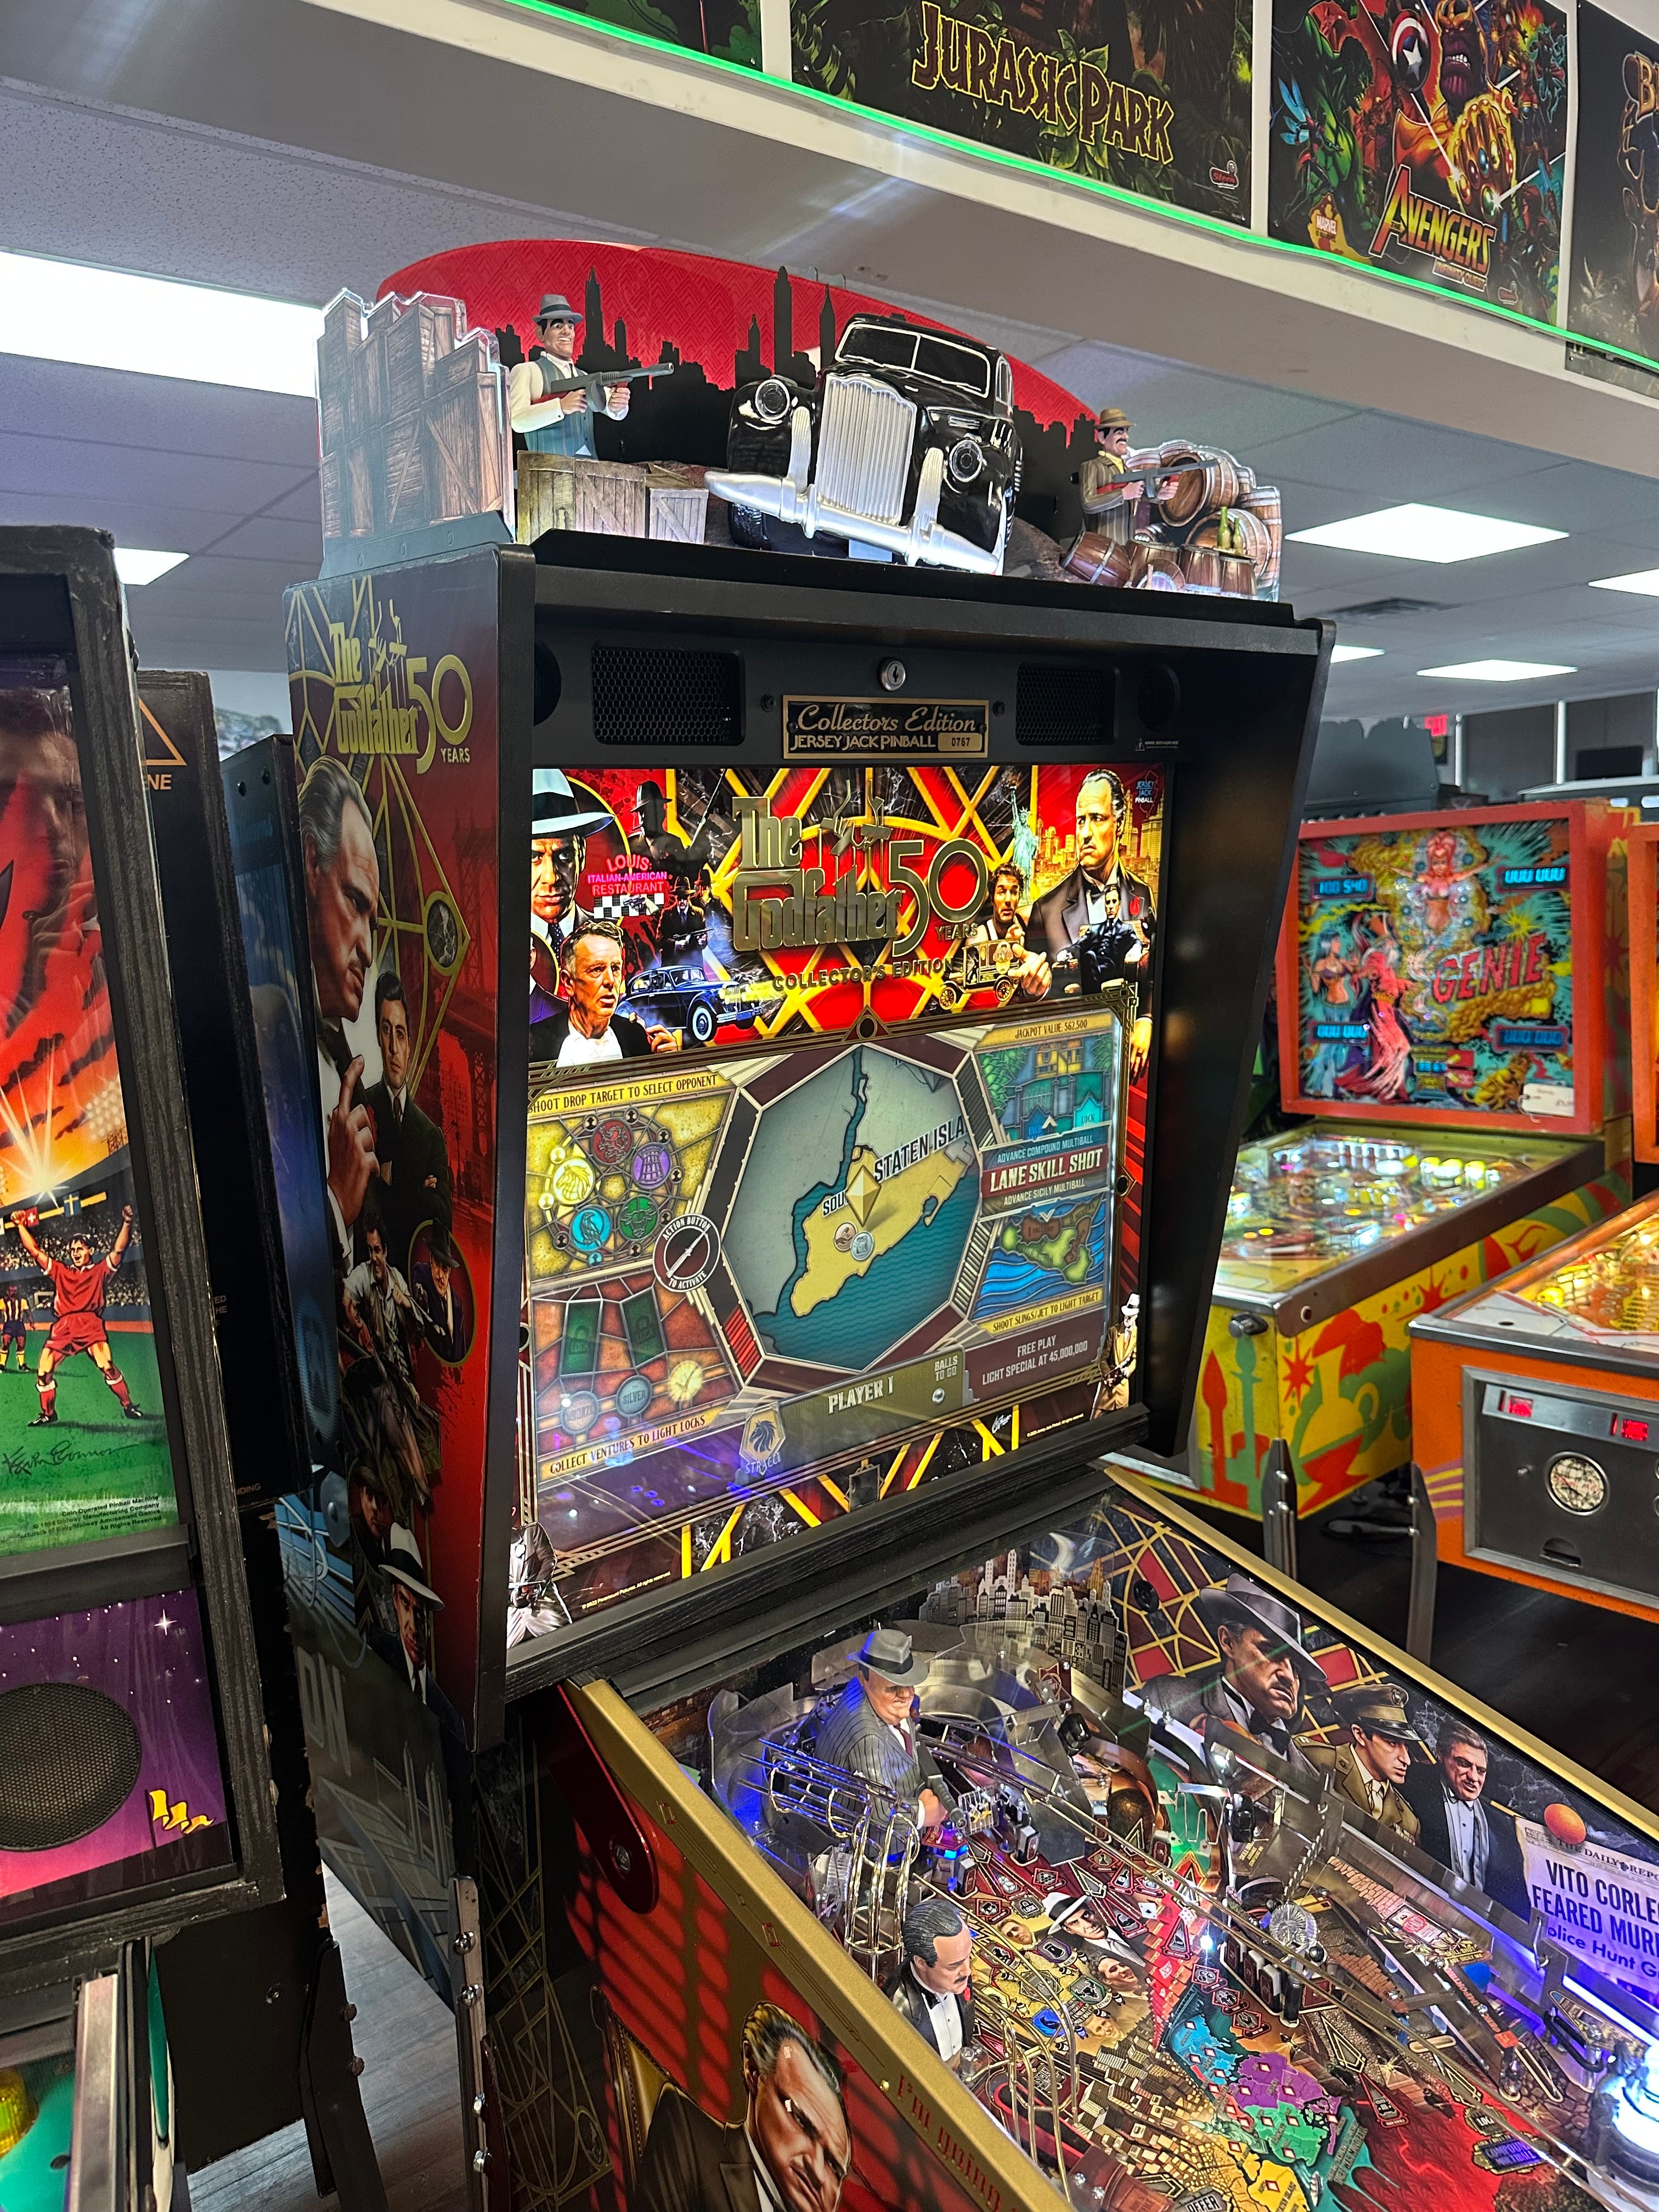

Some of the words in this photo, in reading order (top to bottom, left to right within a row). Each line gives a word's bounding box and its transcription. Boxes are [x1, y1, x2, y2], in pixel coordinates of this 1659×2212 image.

[911, 1, 1076, 135] JURASSIC
[1079, 61, 1175, 166] PARK
[1372, 166, 1496, 273] AVENGERS
[330, 622, 363, 684] The
[334, 681, 420, 754] Godfather
[406, 654, 473, 775] 50
[798, 703, 899, 732] Collectors
[905, 706, 976, 732] Edition
[440, 747, 471, 764] YEARS
[790, 735, 843, 751] JERSEY
[842, 735, 879, 751] JACK
[881, 735, 936, 751] PINBALL
[951, 737, 971, 747] 0767
[1138, 789, 1153, 798] JACK
[732, 796, 803, 869] The
[588, 871, 667, 884] ITALIAN-AMERICAN
[592, 881, 664, 896] RESTAURANT
[733, 868, 902, 952] Godfather
[888, 838, 989, 958] 50
[935, 923, 979, 941] YEARS
[772, 962, 885, 992] COLLECTOR'S
[891, 957, 955, 978] EDITION
[1432, 934, 1546, 1004] GENIE
[1015, 1026, 1042, 1039] JACKPOT
[563, 1094, 587, 1109] DROP
[590, 1088, 625, 1104] TARGET
[628, 1086, 640, 1098] TO
[643, 1081, 674, 1096] SELECT
[676, 1074, 718, 1091] OPPONENT
[873, 1132, 929, 1182] STATEN
[997, 1149, 1026, 1165] ADVANCE
[1027, 1142, 1061, 1158] COMPOUND
[1062, 1134, 1093, 1151] MULTIBALL
[989, 1166, 1028, 1193] LANE
[1029, 1158, 1065, 1182] SKILL
[1068, 1148, 1103, 1172] SHOT
[1003, 1191, 1032, 1206] ADVANCE
[1032, 1187, 1053, 1201] SICILY
[1053, 1178, 1086, 1194] MULTIBALL
[662, 1218, 685, 1240] ACTION
[686, 1216, 712, 1230] BUTTON
[668, 1278, 678, 1288] TO
[678, 1270, 707, 1289] ACTIVATE
[992, 1318, 1013, 1332] SHOOT
[1014, 1307, 1048, 1325] SLINGS/JET
[1050, 1305, 1058, 1313] TO
[1059, 1298, 1077, 1312] LIGHT
[1079, 1291, 1099, 1305] TARGET
[1017, 1341, 1036, 1358] FREE
[1037, 1334, 1057, 1351] PLAY
[934, 1355, 958, 1371] BALLS
[935, 1369, 945, 1381] TO
[946, 1365, 957, 1379] GO
[982, 1368, 1005, 1386] LIGHT
[1006, 1358, 1037, 1378] SPECIAL
[1038, 1353, 1048, 1367] AT
[1048, 1340, 1088, 1362] 45,000,000
[622, 1390, 646, 1405] SILVER
[827, 1379, 884, 1414] PLAYER
[550, 1453, 588, 1474] COLLECT
[590, 1438, 635, 1461] VENTURES
[637, 1434, 650, 1446] TO
[652, 1424, 678, 1442] LIGHT
[680, 1415, 706, 1432] LOCKS
[78, 1504, 108, 1515] Operated
[109, 1500, 131, 1509] Pinball
[132, 1495, 159, 1504] Machine
[82, 1508, 128, 1521] Manufacturing
[129, 1502, 160, 1512] Company
[99, 1514, 138, 1525] Amusement
[139, 1509, 161, 1517] Games
[110, 1521, 131, 1531] Rights
[132, 1515, 162, 1525] Reserved
[1584, 1848, 1620, 1866] DAILY
[1545, 1859, 1589, 1899] VITO
[1595, 1878, 1659, 1927] CORLE
[1022, 1905, 1037, 1914] LOCK
[1532, 1884, 1602, 1935] FEARED
[1610, 1914, 1659, 1960] MUR
[1593, 1940, 1637, 1969] Hunt
[1034, 2067, 1051, 2085] SICILY
[1186, 2195, 1221, 2212] OFFER
